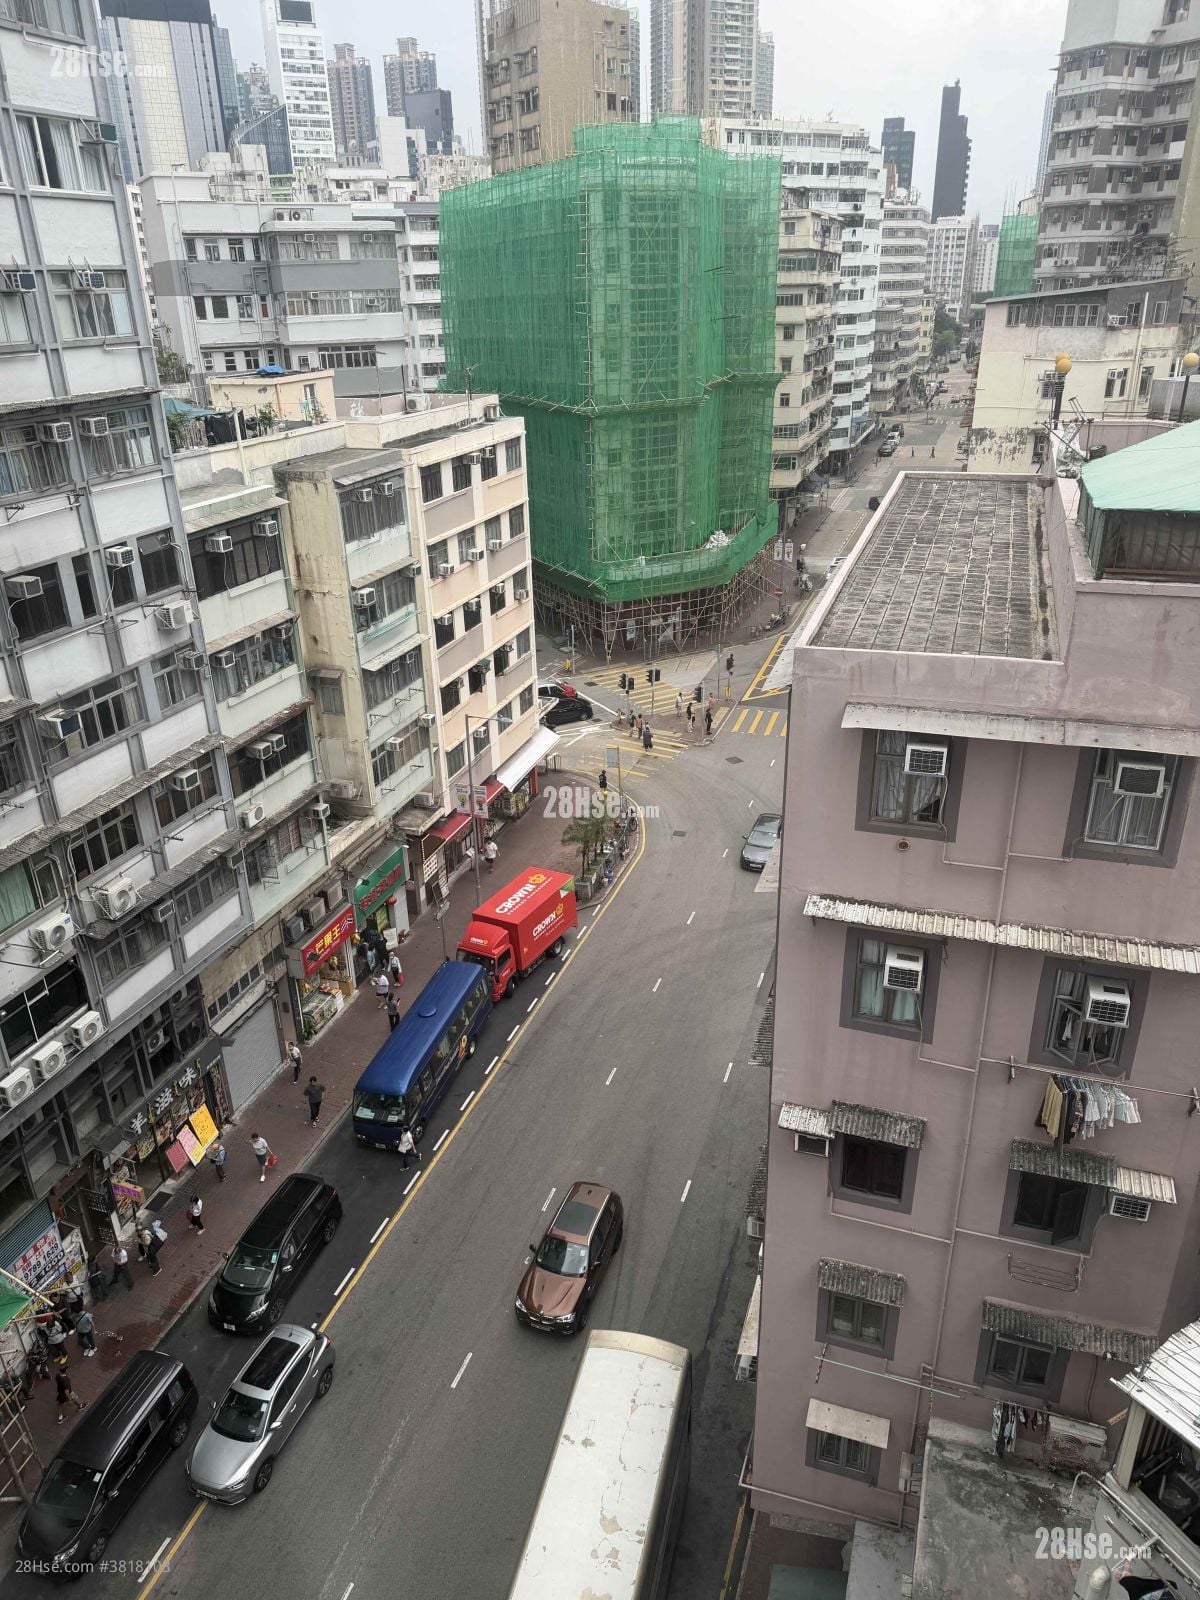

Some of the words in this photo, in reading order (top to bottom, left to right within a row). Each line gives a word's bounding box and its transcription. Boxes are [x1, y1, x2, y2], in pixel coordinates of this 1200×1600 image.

[495, 883, 537, 914] CROWN
[532, 910, 557, 937] CROWN
[23, 1260, 42, 1281] 9789
[42, 1242, 59, 1262] 1629
